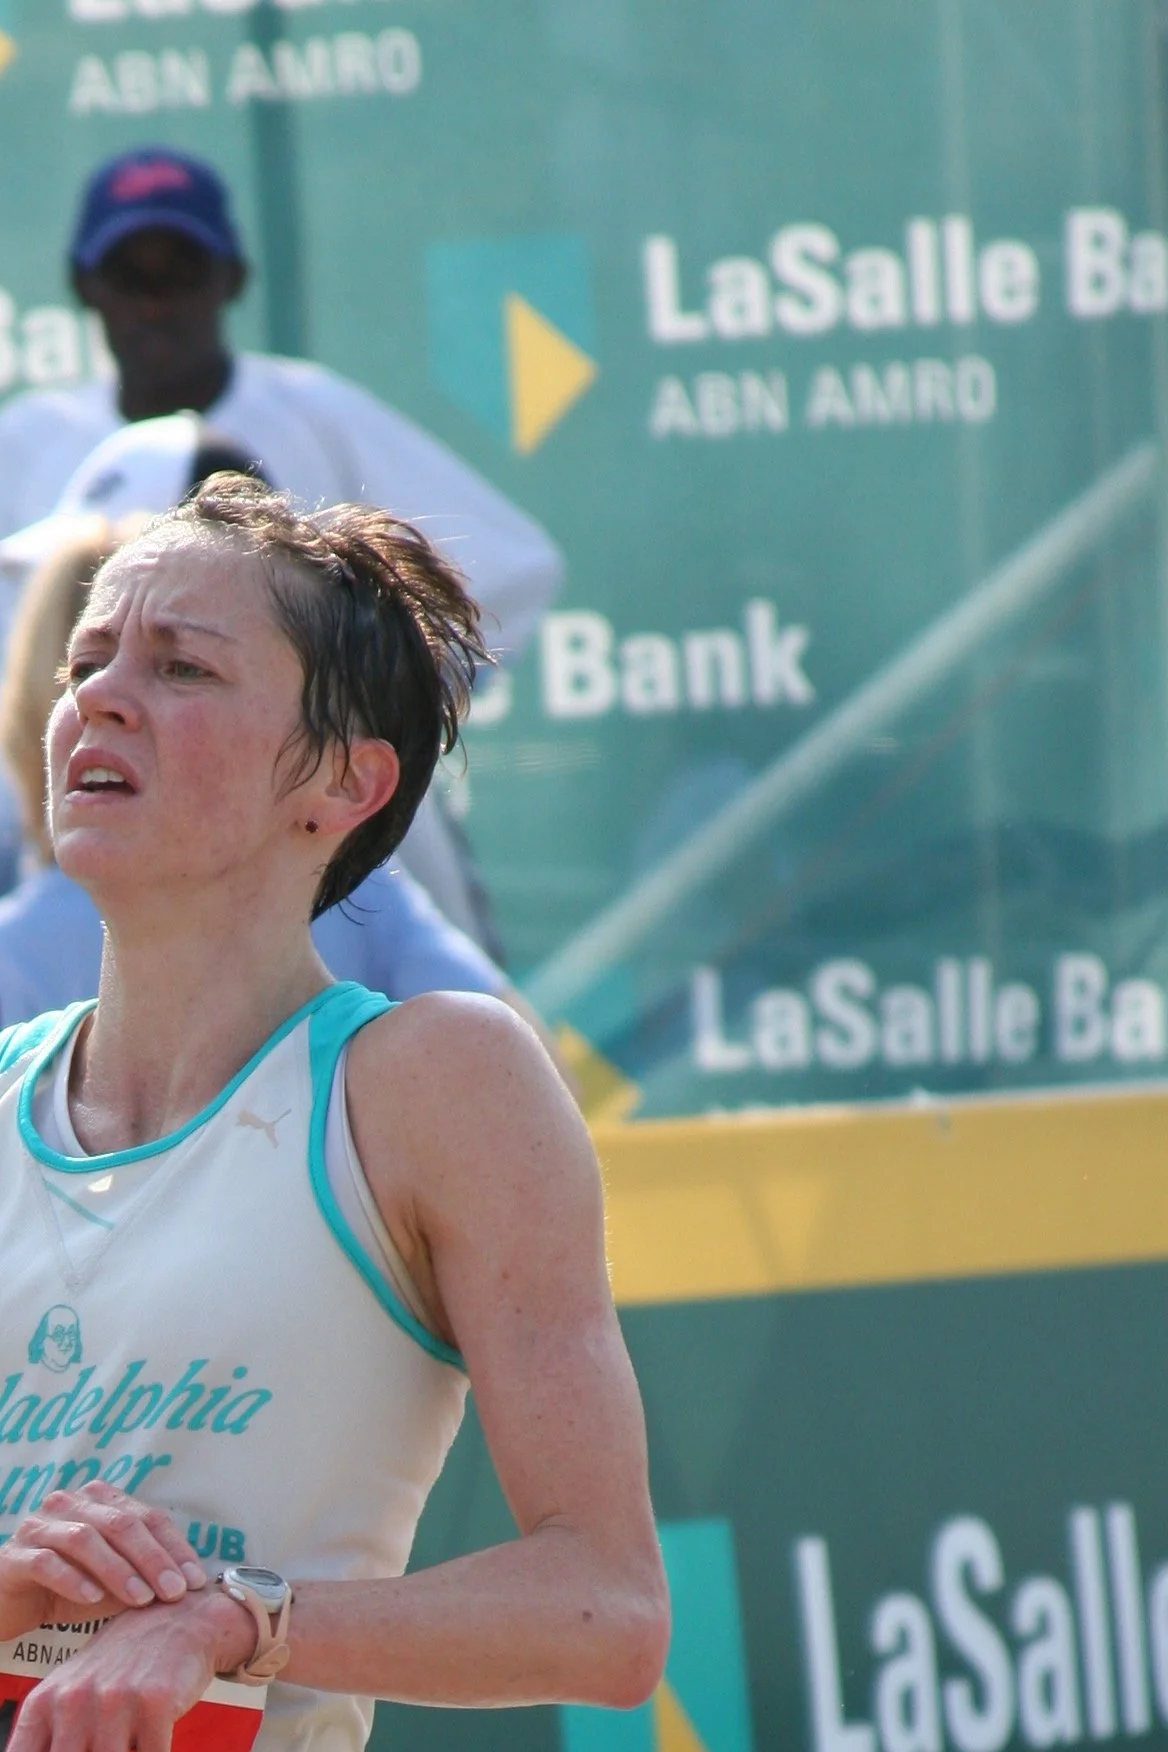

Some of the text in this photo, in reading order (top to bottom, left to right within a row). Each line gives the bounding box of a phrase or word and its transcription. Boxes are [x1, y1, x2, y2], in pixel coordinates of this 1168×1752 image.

[68, 27, 423, 117] ABN AMRO
[644, 213, 1039, 344] LaSalle
[648, 353, 998, 440] ABN AMRO
[542, 598, 817, 720] Bank
[693, 951, 1168, 1072] LaSalle Ba
[187, 1519, 246, 1563] UB
[12, 1641, 79, 1665] ABN AM
